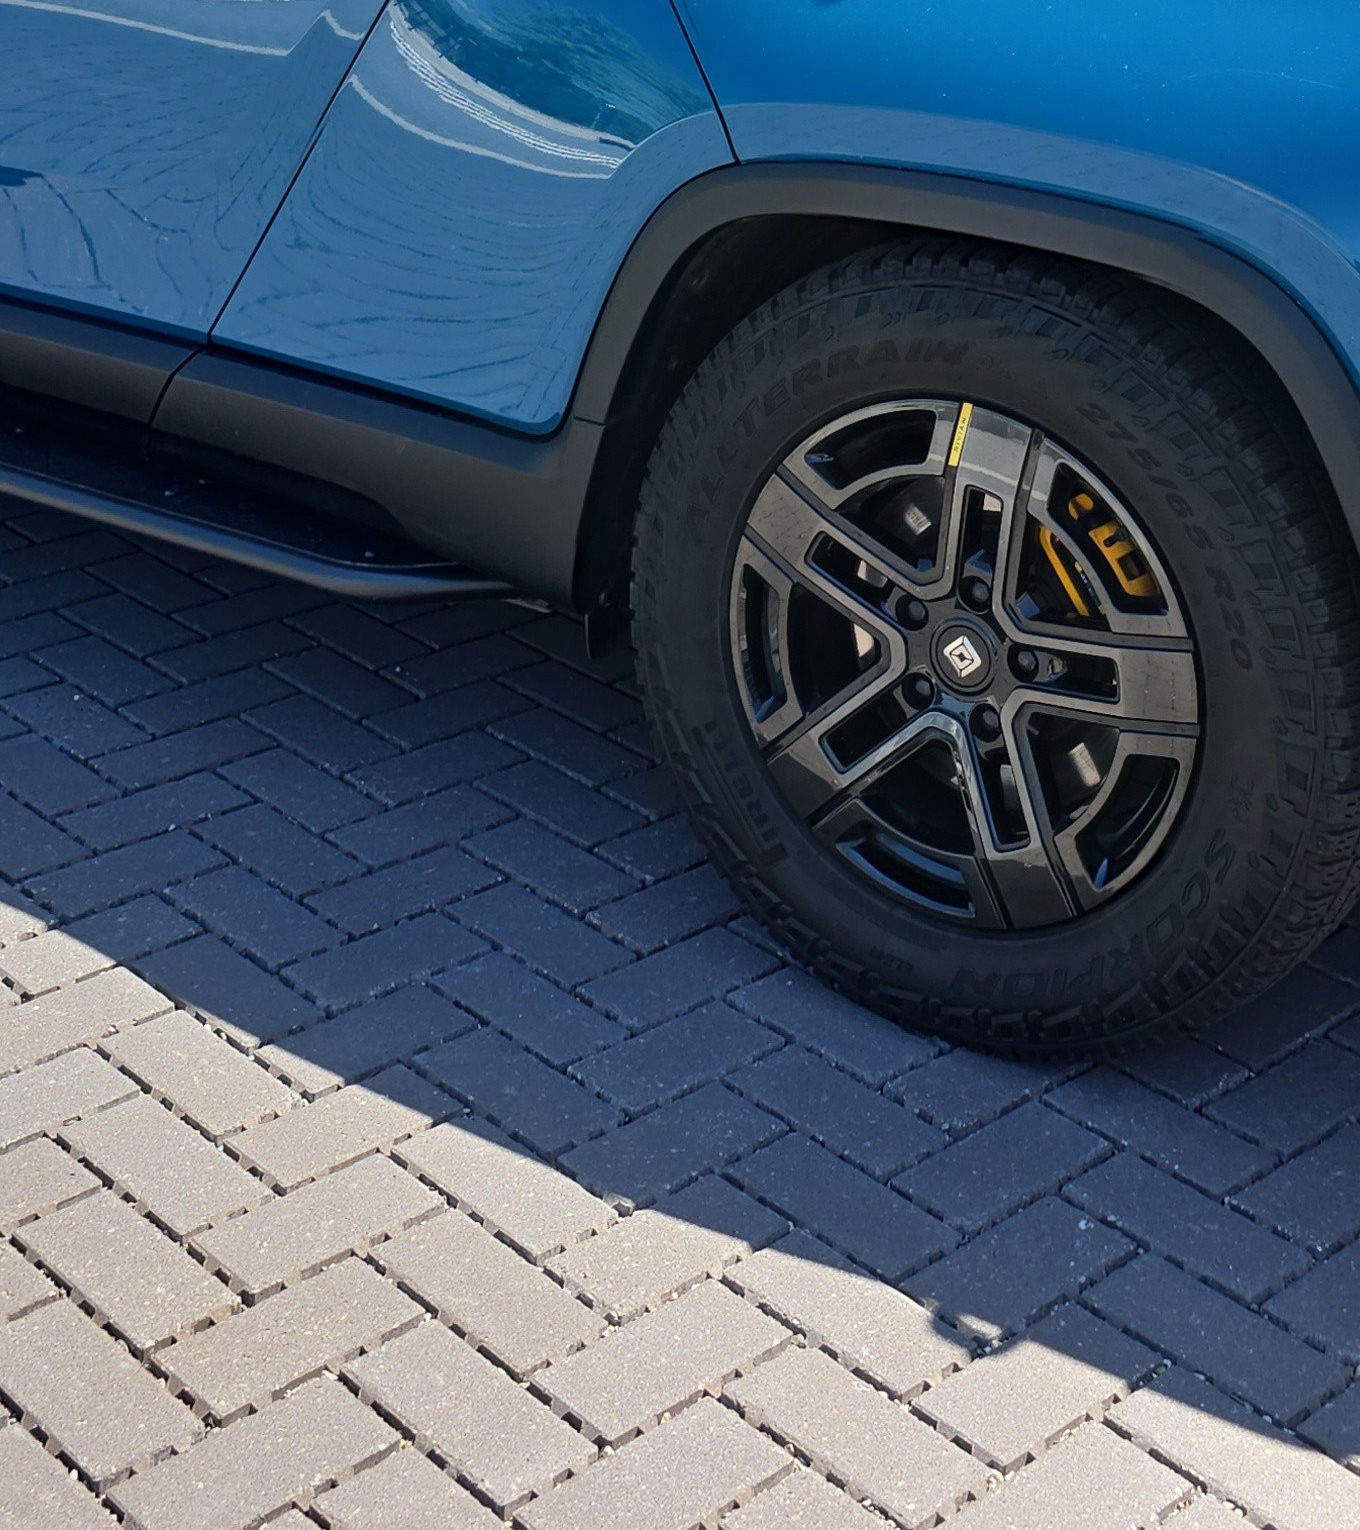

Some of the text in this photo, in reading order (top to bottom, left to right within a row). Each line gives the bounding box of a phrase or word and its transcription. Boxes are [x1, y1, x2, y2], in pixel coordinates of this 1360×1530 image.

[732, 337, 970, 438] TERRAIN
[1075, 401, 1254, 671] 275/65 R20
[948, 827, 1237, 998] SCORPION
